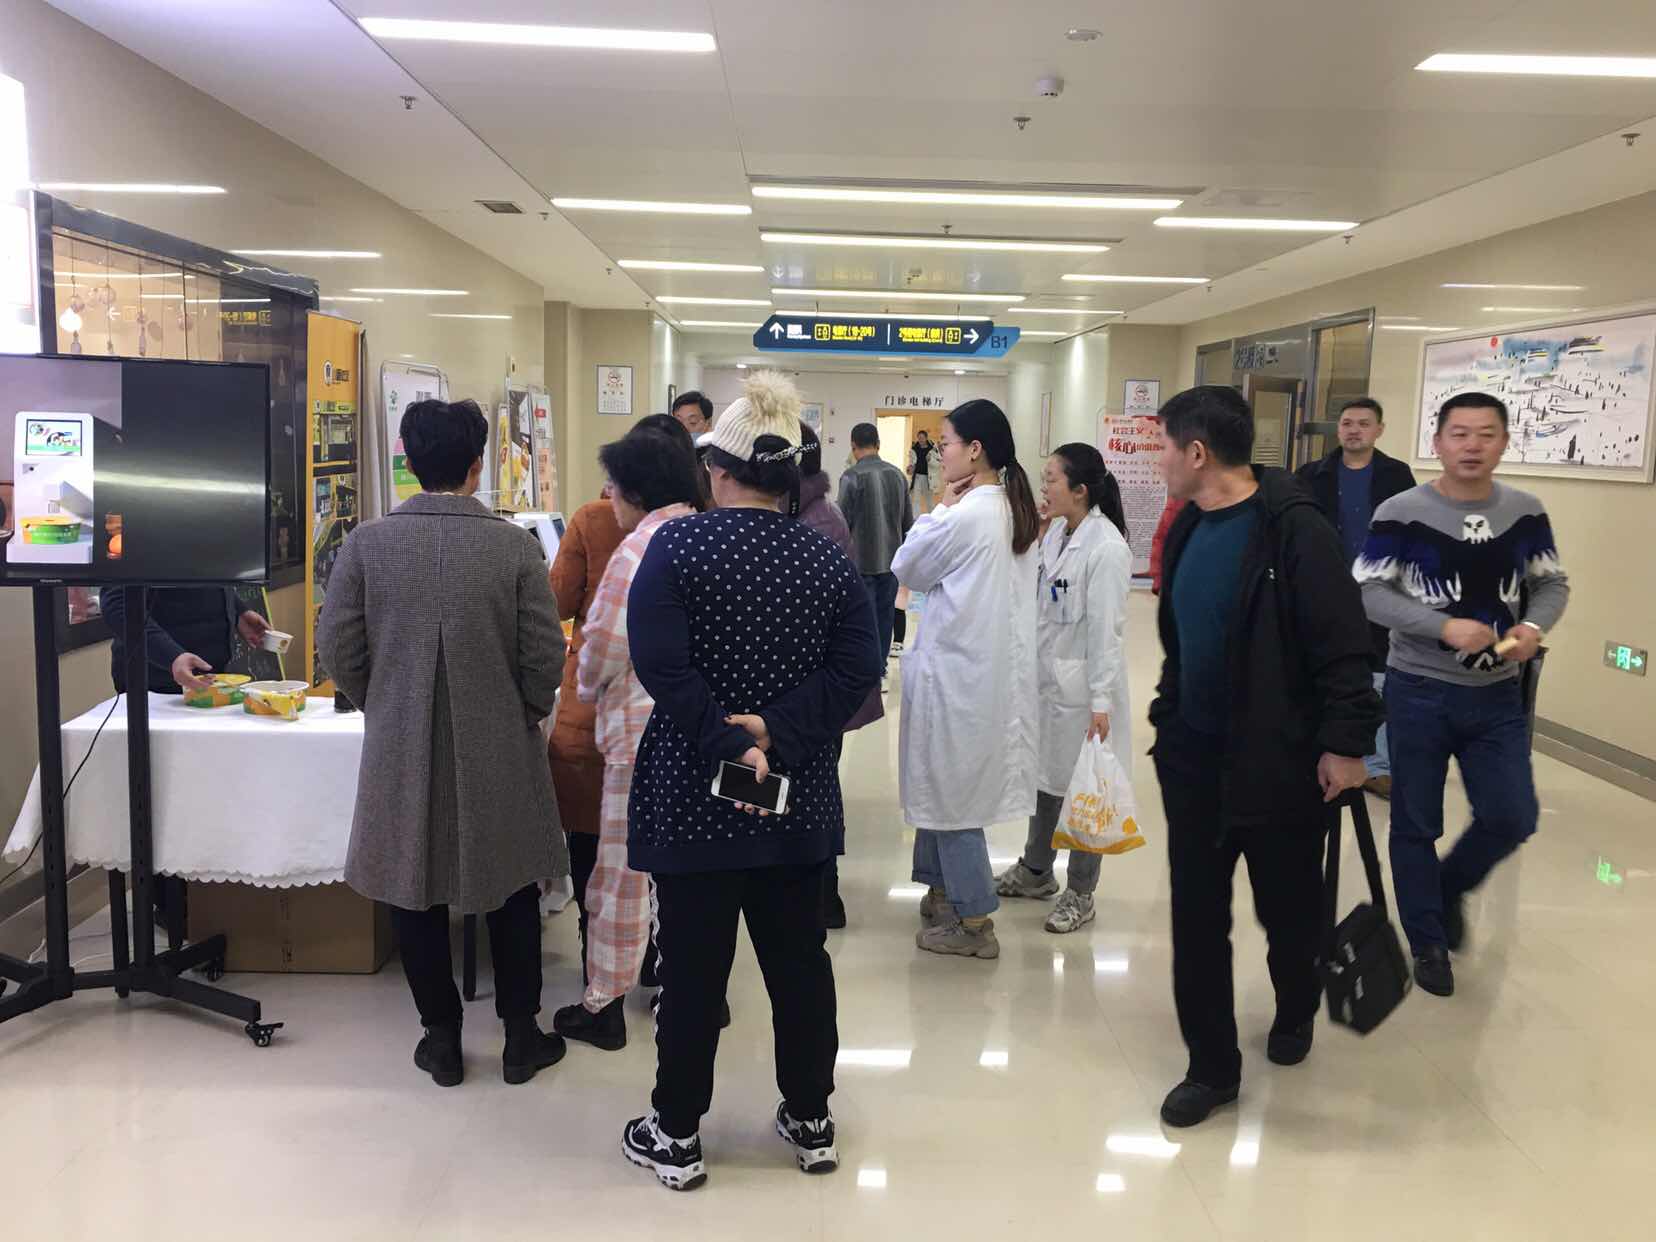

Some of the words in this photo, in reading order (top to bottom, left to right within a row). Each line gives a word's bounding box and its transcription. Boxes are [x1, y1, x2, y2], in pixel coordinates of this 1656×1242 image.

[991, 336, 1008, 349] B1
[884, 395, 944, 407] 门诊电梯厅
